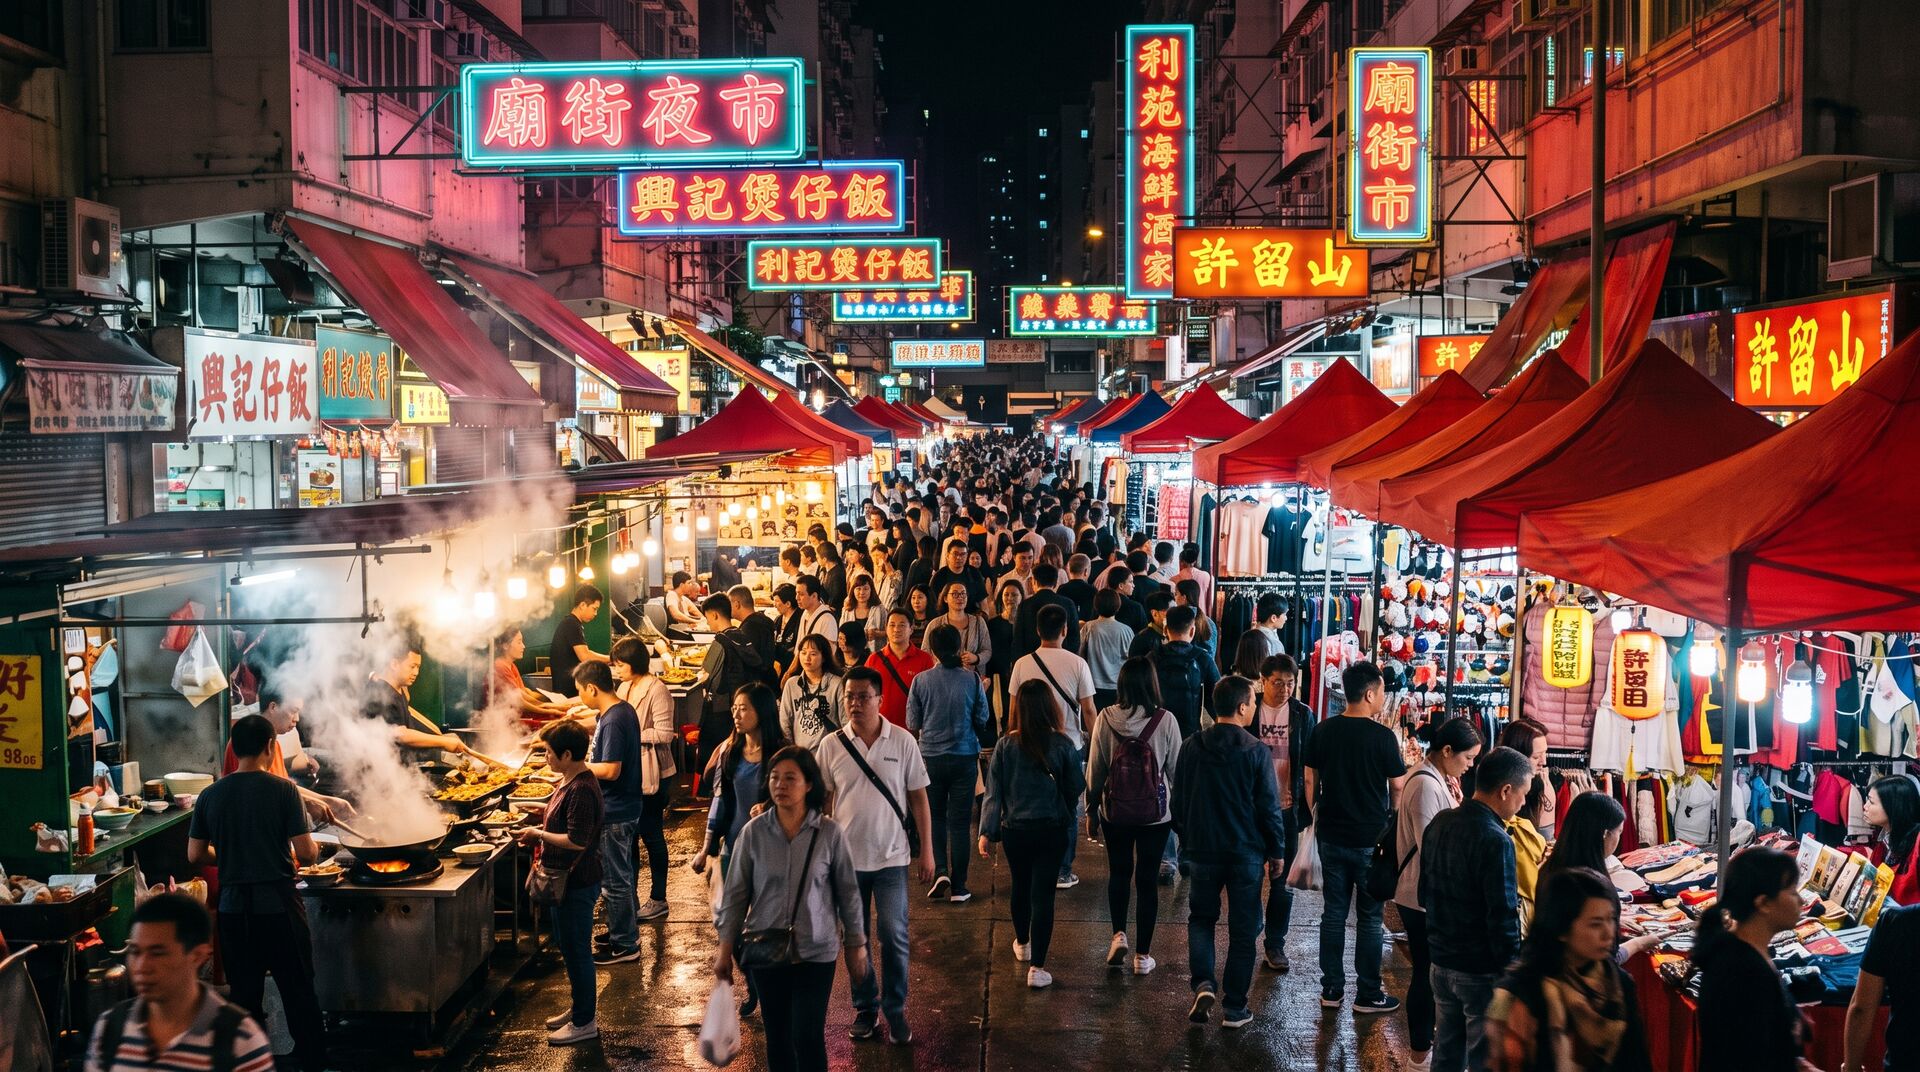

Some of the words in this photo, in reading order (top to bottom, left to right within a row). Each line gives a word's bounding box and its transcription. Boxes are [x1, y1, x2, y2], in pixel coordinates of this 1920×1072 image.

[484, 75, 784, 147] 廟街夜市
[1364, 62, 1416, 230] 廟街市
[631, 173, 893, 222] 興記煲仔飯
[1139, 38, 1182, 287] 利苑海鮮酒家
[757, 247, 934, 281] 利記煲仔飯
[1189, 238, 1352, 289] 許留山
[199, 352, 312, 424] 興記仔飯
[1749, 310, 1865, 398] 許留山
